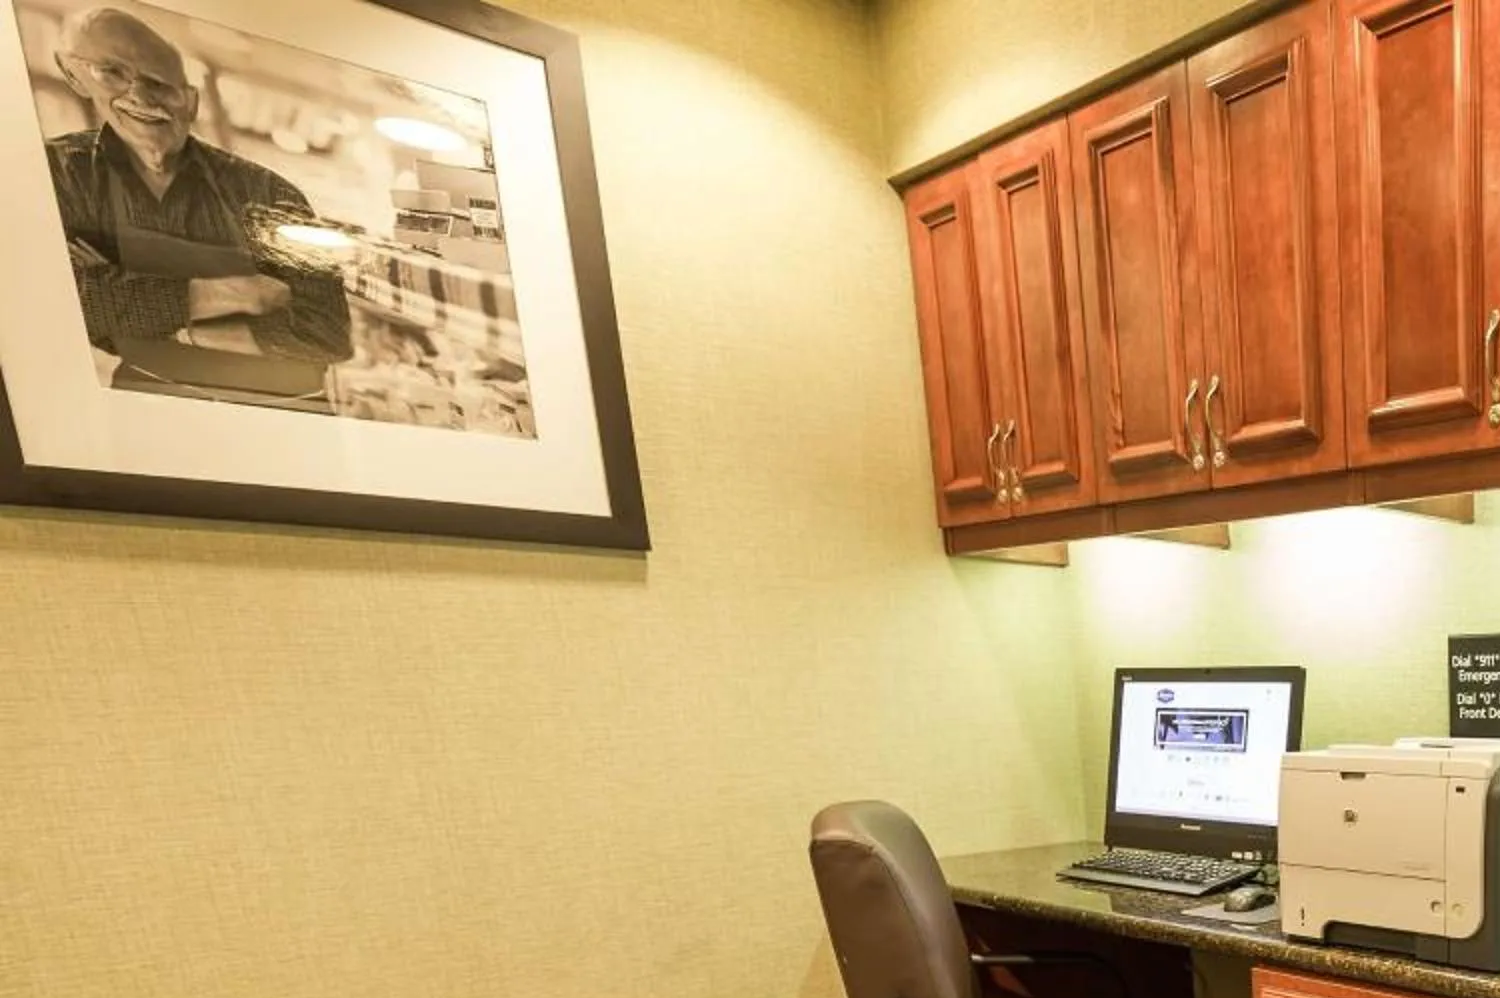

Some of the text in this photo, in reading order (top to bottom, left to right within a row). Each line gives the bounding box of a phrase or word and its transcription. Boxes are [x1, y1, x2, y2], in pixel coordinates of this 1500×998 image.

[1452, 653, 1472, 668] Dial
[1475, 653, 1500, 667] "911"
[1457, 692, 1477, 705] Dial
[1459, 706, 1486, 718] Front
